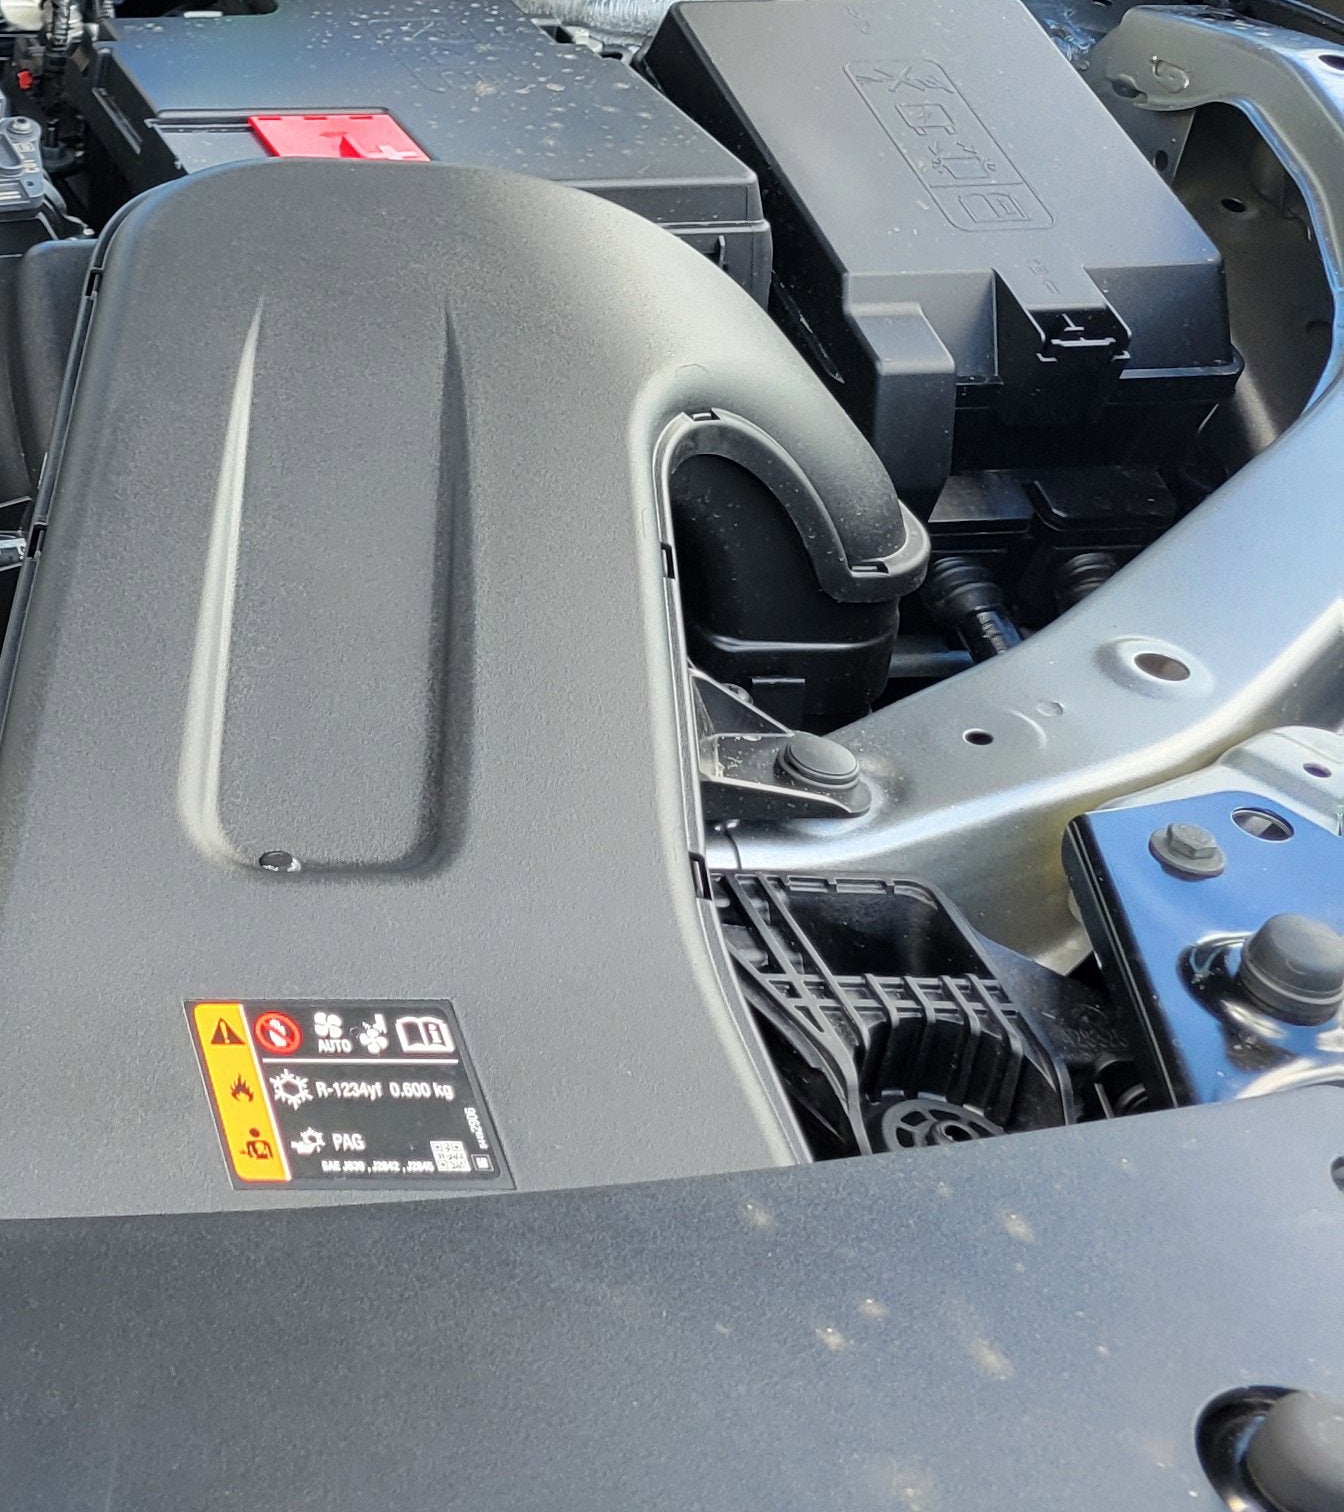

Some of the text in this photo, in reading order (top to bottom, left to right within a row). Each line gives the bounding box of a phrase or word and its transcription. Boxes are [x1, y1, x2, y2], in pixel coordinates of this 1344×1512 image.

[318, 1038, 353, 1054] AUTO
[314, 1081, 455, 1102] R-1234yf 0.600 kg
[331, 1133, 366, 1152] PAG
